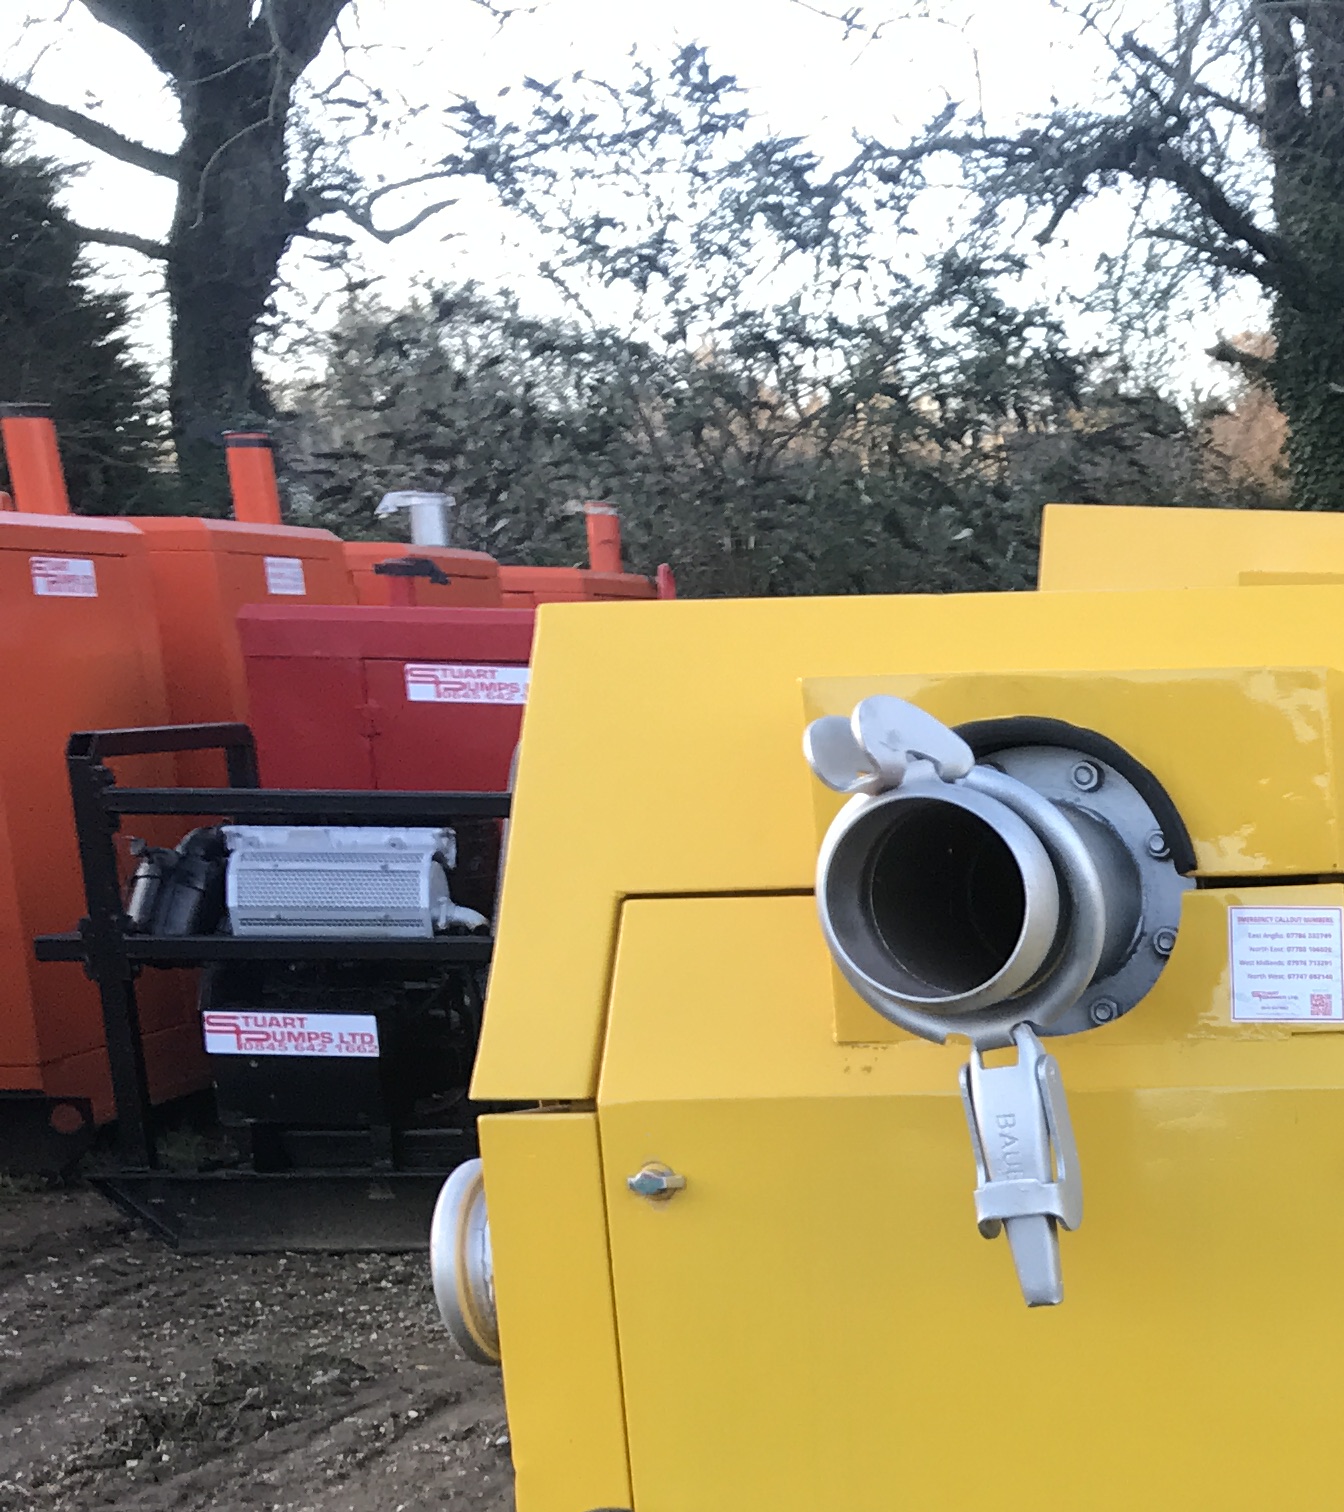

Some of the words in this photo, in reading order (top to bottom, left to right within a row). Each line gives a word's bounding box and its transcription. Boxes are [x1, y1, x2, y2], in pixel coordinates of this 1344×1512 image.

[206, 1014, 308, 1030] STUART
[206, 1029, 334, 1051] PUMPS
[339, 1032, 375, 1045] LTD
[996, 1113, 1024, 1179] BAUE
